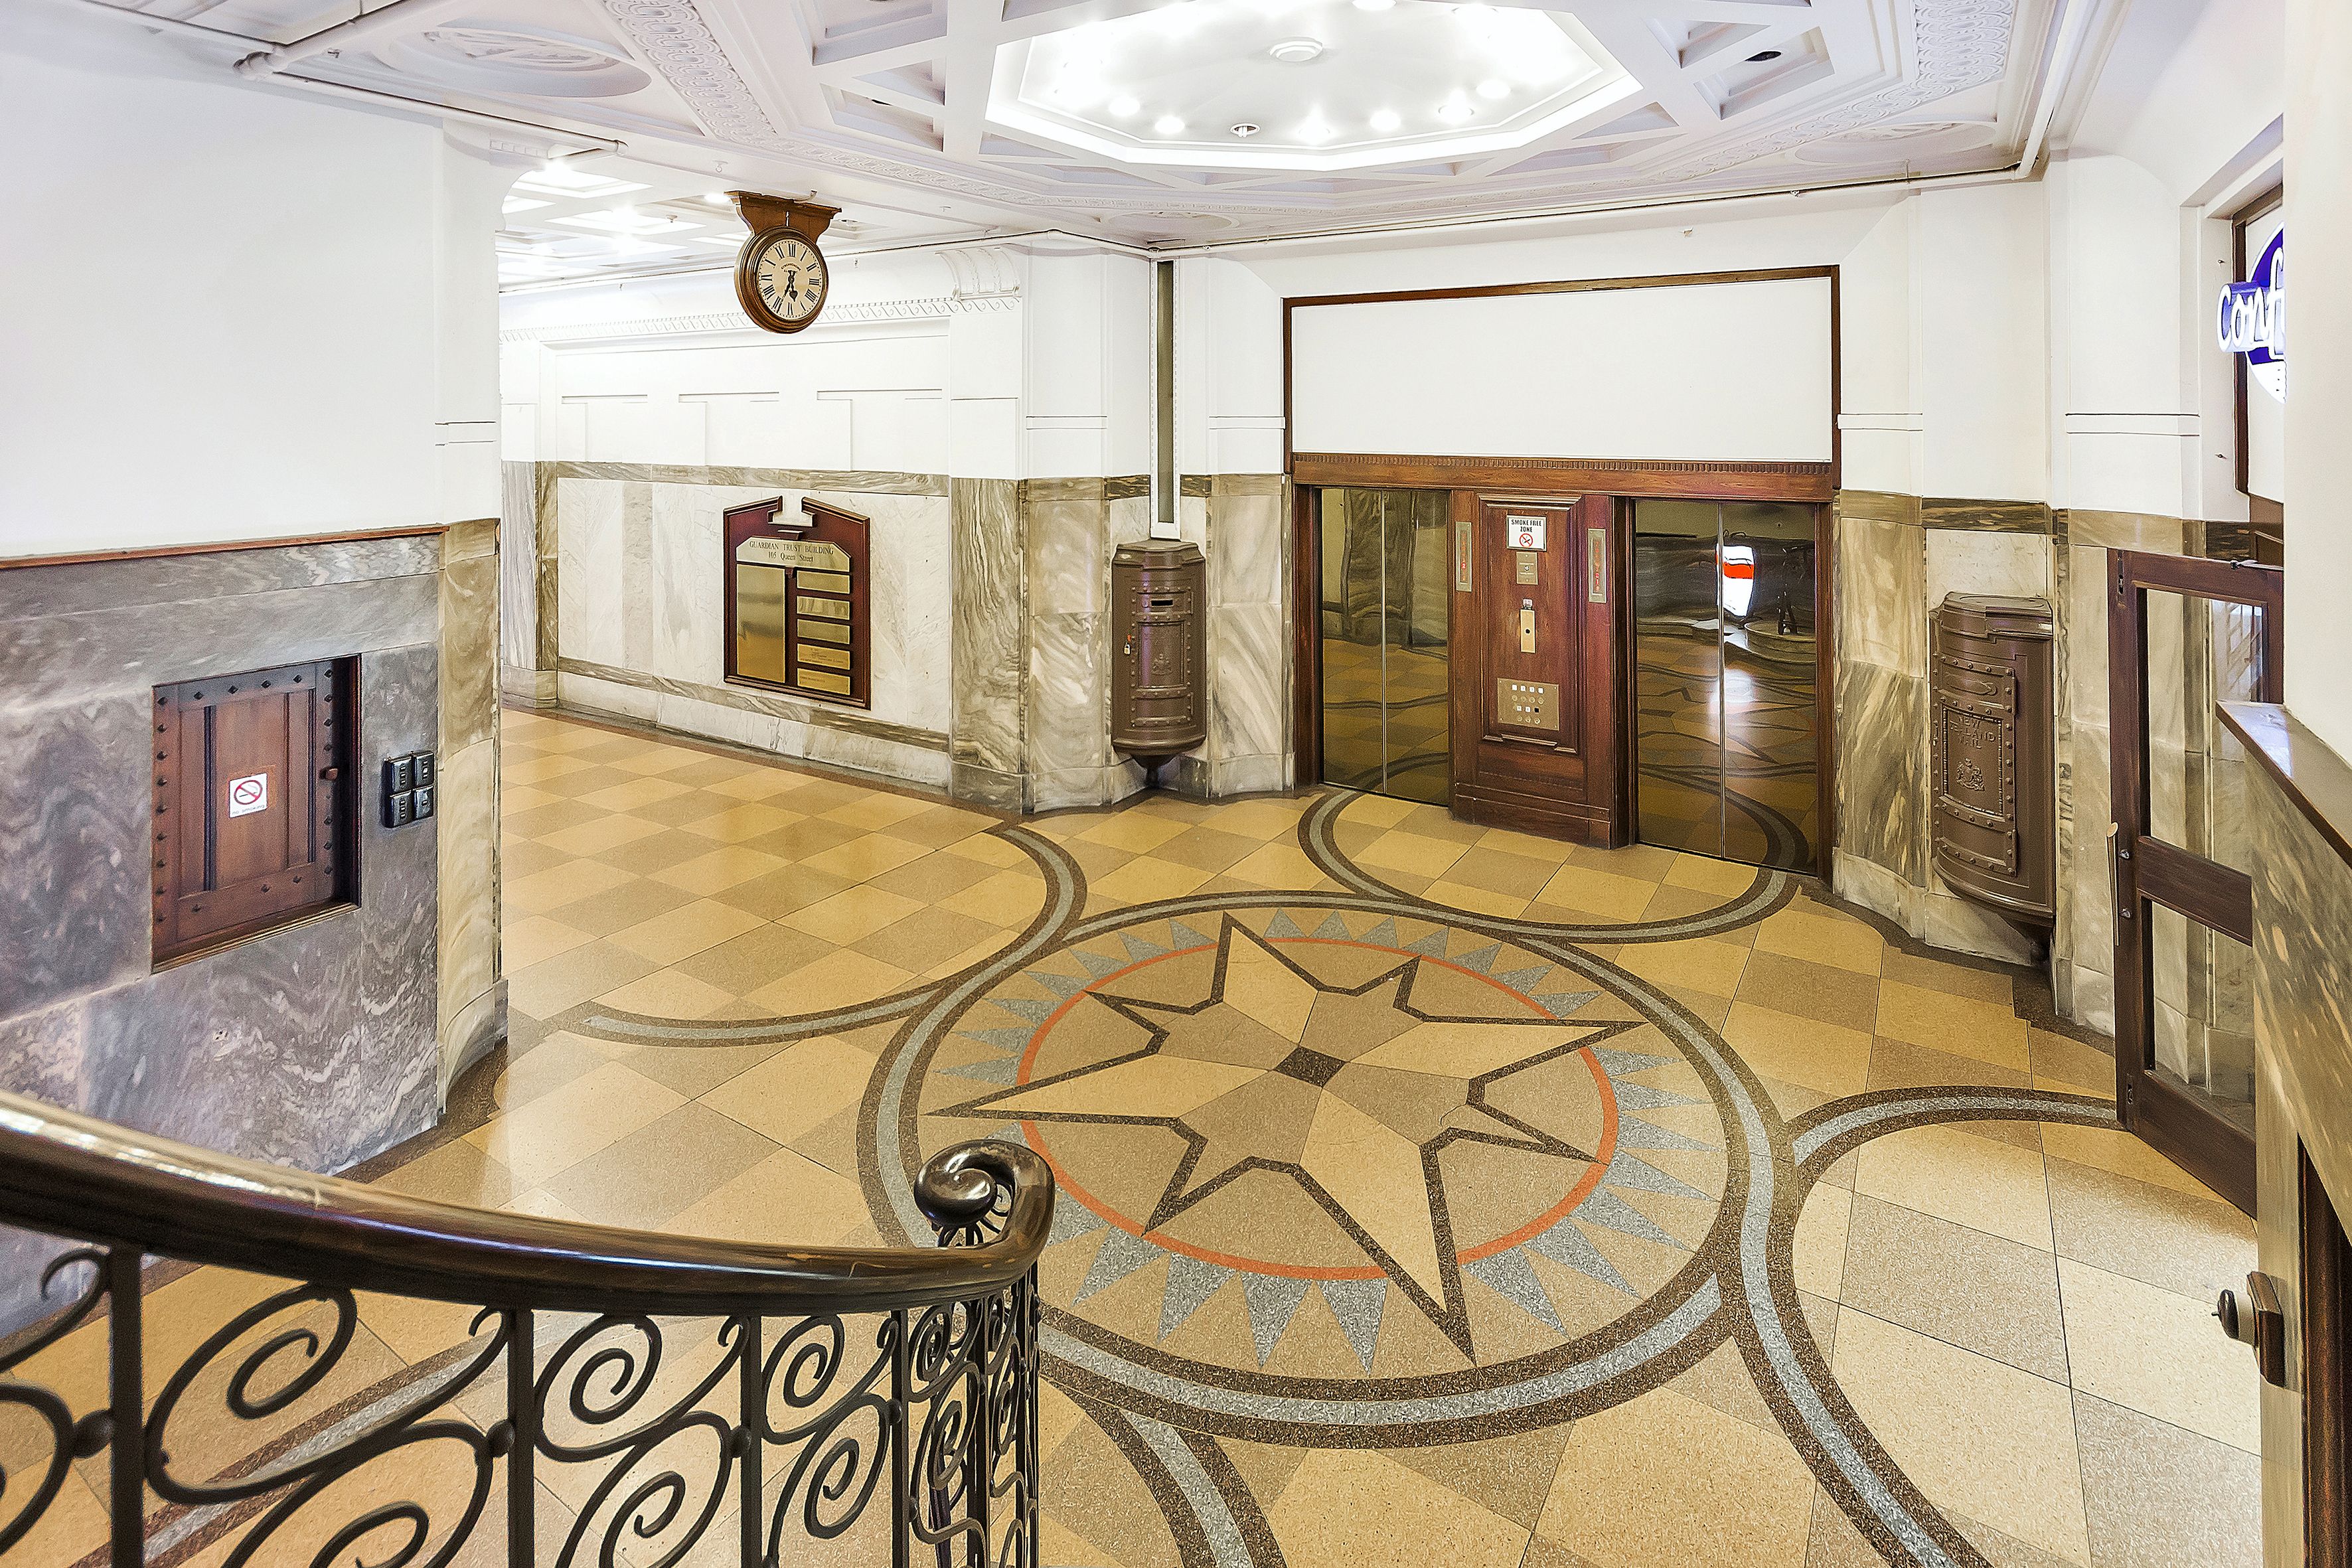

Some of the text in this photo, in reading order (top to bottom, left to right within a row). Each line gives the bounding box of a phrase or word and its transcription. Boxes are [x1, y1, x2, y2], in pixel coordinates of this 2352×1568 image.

[749, 540, 834, 555] GUARDIAN TRUST BUILDING
[780, 552, 796, 561] Queen
[1958, 715, 1981, 729] NEW
